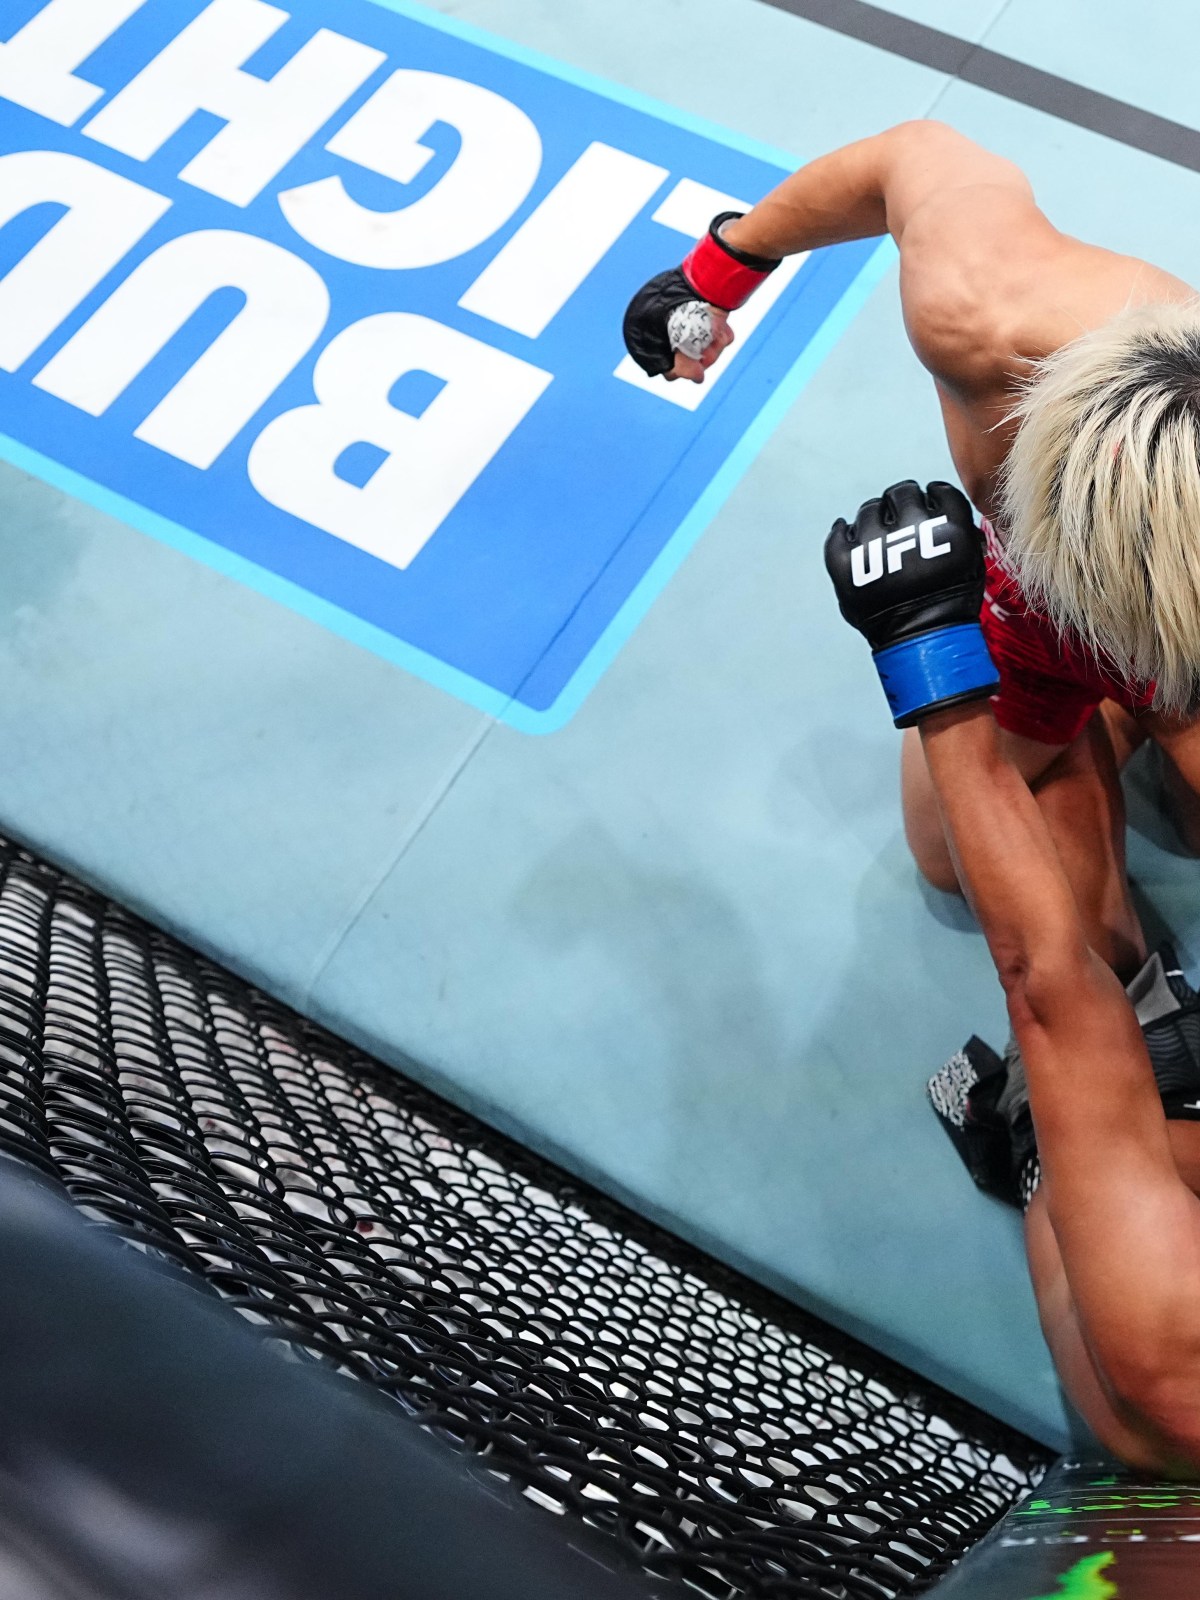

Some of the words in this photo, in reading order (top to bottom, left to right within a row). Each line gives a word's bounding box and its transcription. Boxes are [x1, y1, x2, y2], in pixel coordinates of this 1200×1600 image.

[0, 0, 811, 411] LIGHT
[0, 150, 554, 570] BUD
[851, 514, 951, 587] UFC
